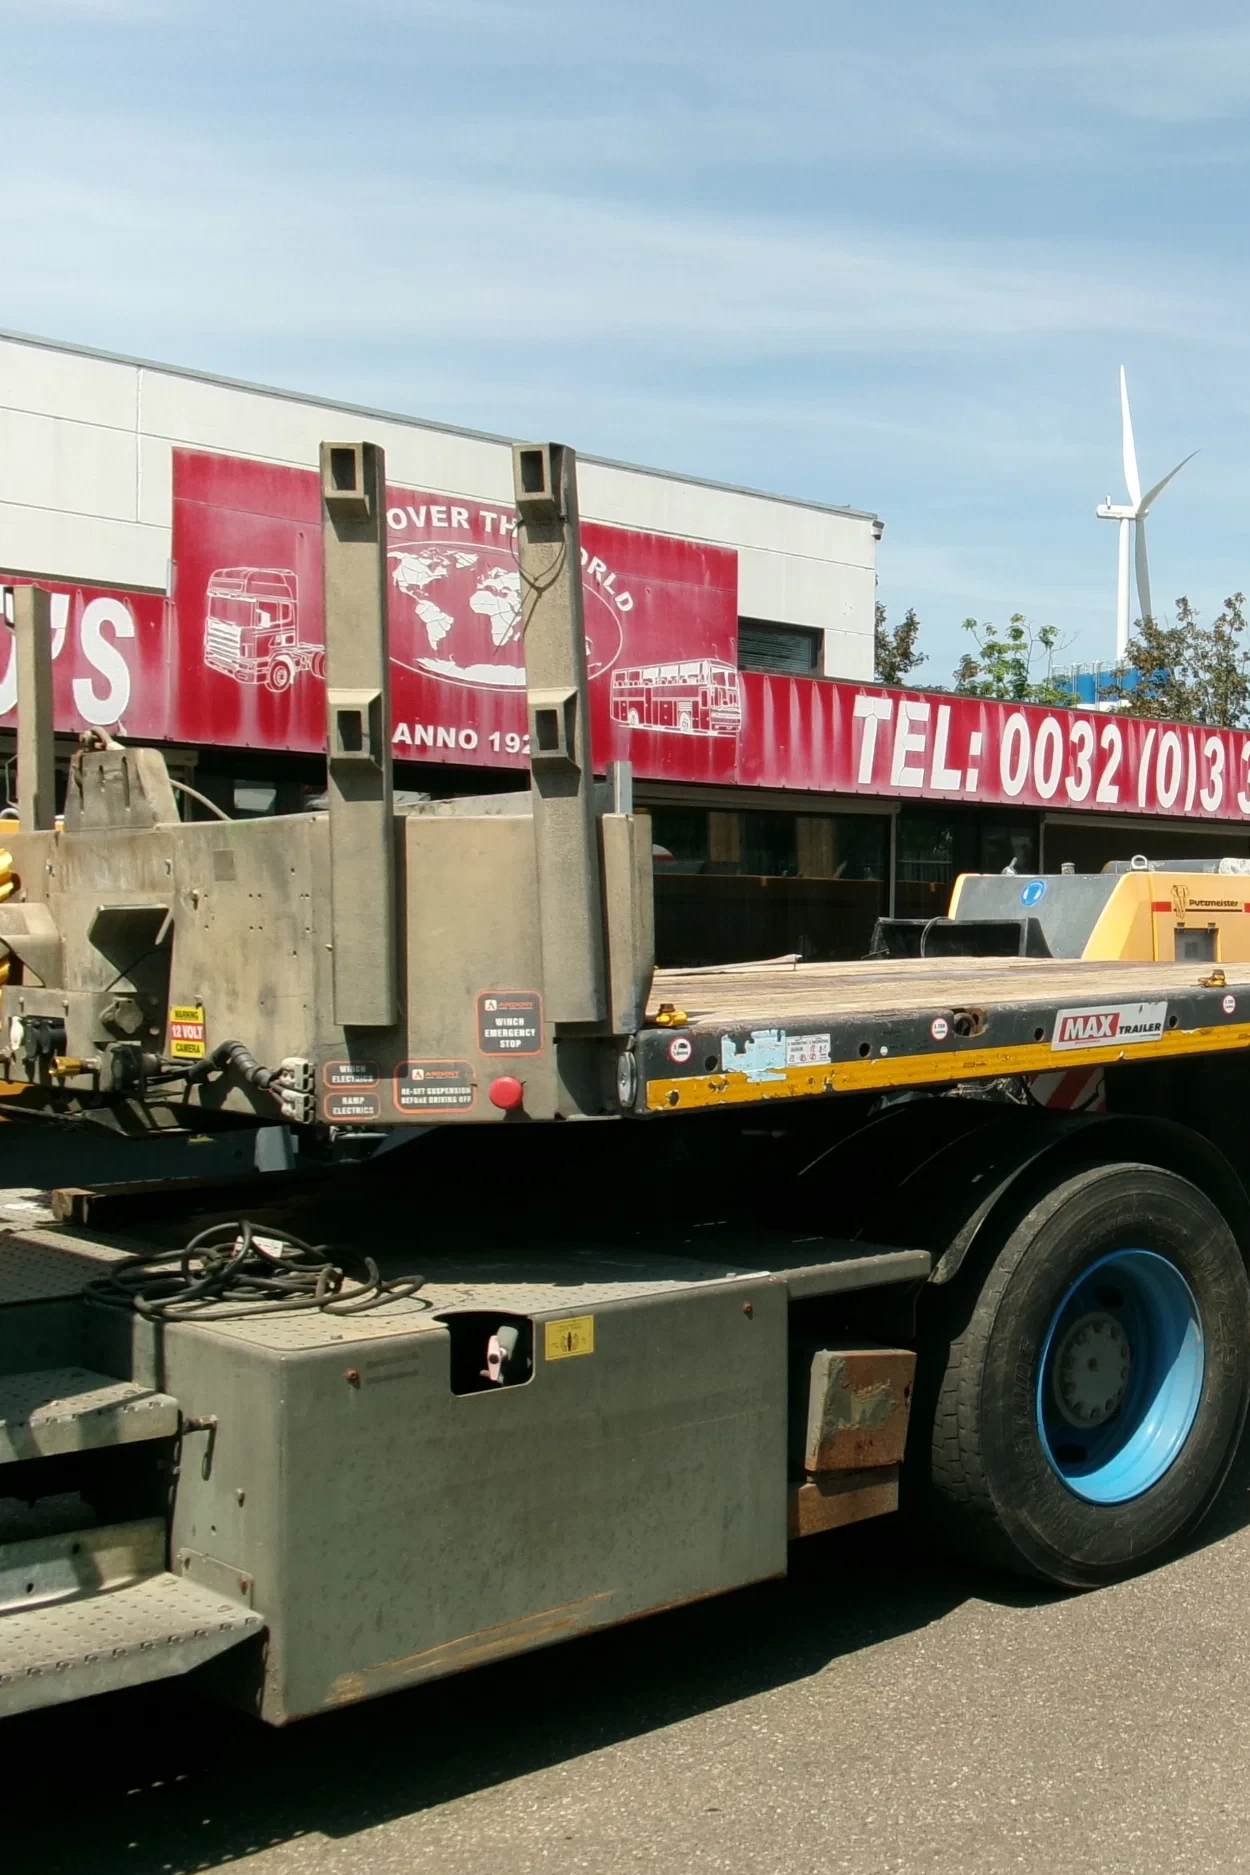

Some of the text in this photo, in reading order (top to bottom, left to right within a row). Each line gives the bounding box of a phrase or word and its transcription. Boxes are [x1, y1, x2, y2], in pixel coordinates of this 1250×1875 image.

[387, 505, 518, 538] OVER TH
[391, 722, 531, 754] ANNO 192
[853, 694, 983, 793] TEL:
[1000, 712, 1123, 804] 0032
[1138, 728, 1225, 812] (0)3
[1188, 899, 1239, 908] Putzmeister
[495, 1018, 525, 1026] WINCH
[172, 1024, 203, 1039] 12 VOLT
[484, 1028, 536, 1037] EMERGENCY
[1063, 1015, 1162, 1041] MAX TRAILER
[499, 1039, 521, 1048] STOP
[427, 1086, 472, 1094] SUSPENSION
[342, 1096, 365, 1105] RAMP
[401, 1097, 427, 1105] BEFORE
[429, 1096, 457, 1104] DRIVING
[332, 1106, 375, 1115] ELECTRICS
